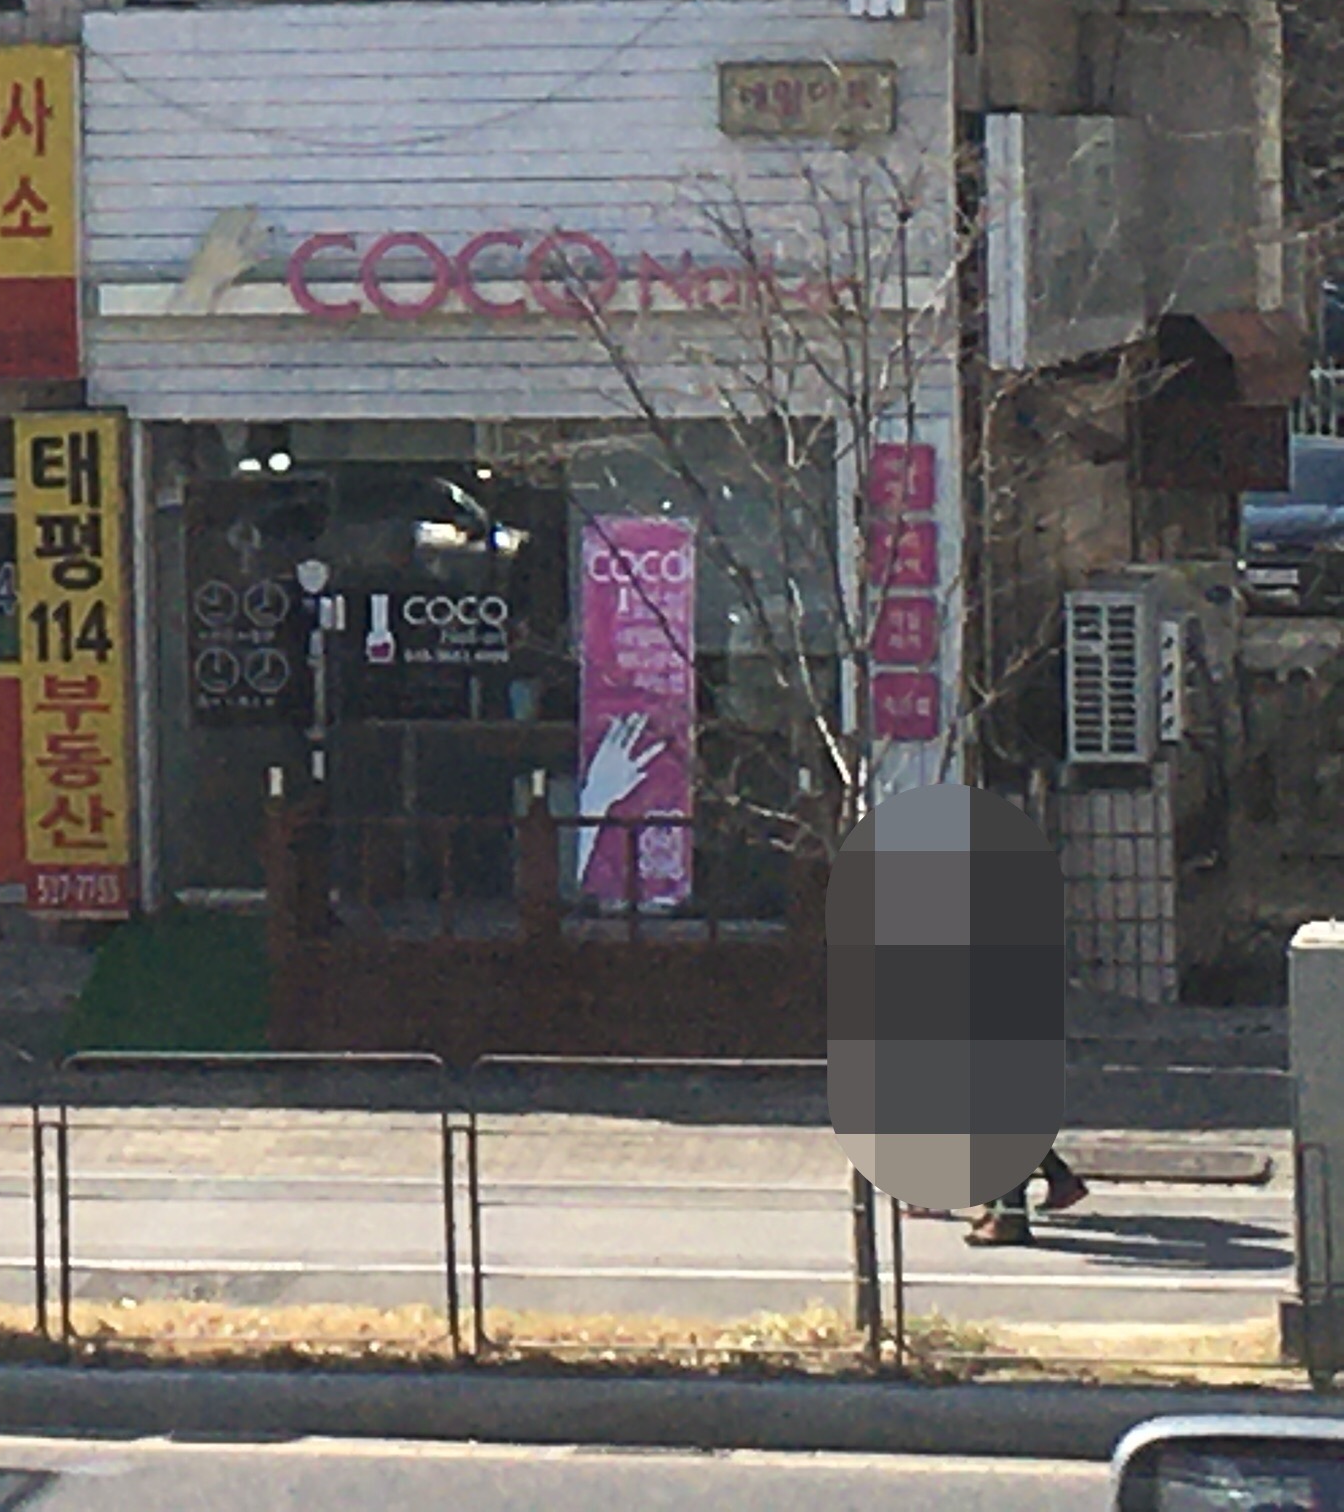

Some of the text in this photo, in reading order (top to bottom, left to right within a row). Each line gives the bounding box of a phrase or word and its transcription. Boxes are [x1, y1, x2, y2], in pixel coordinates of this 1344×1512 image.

[287, 229, 618, 321] COCO
[587, 550, 689, 582] COCO
[403, 596, 508, 626] COCO
